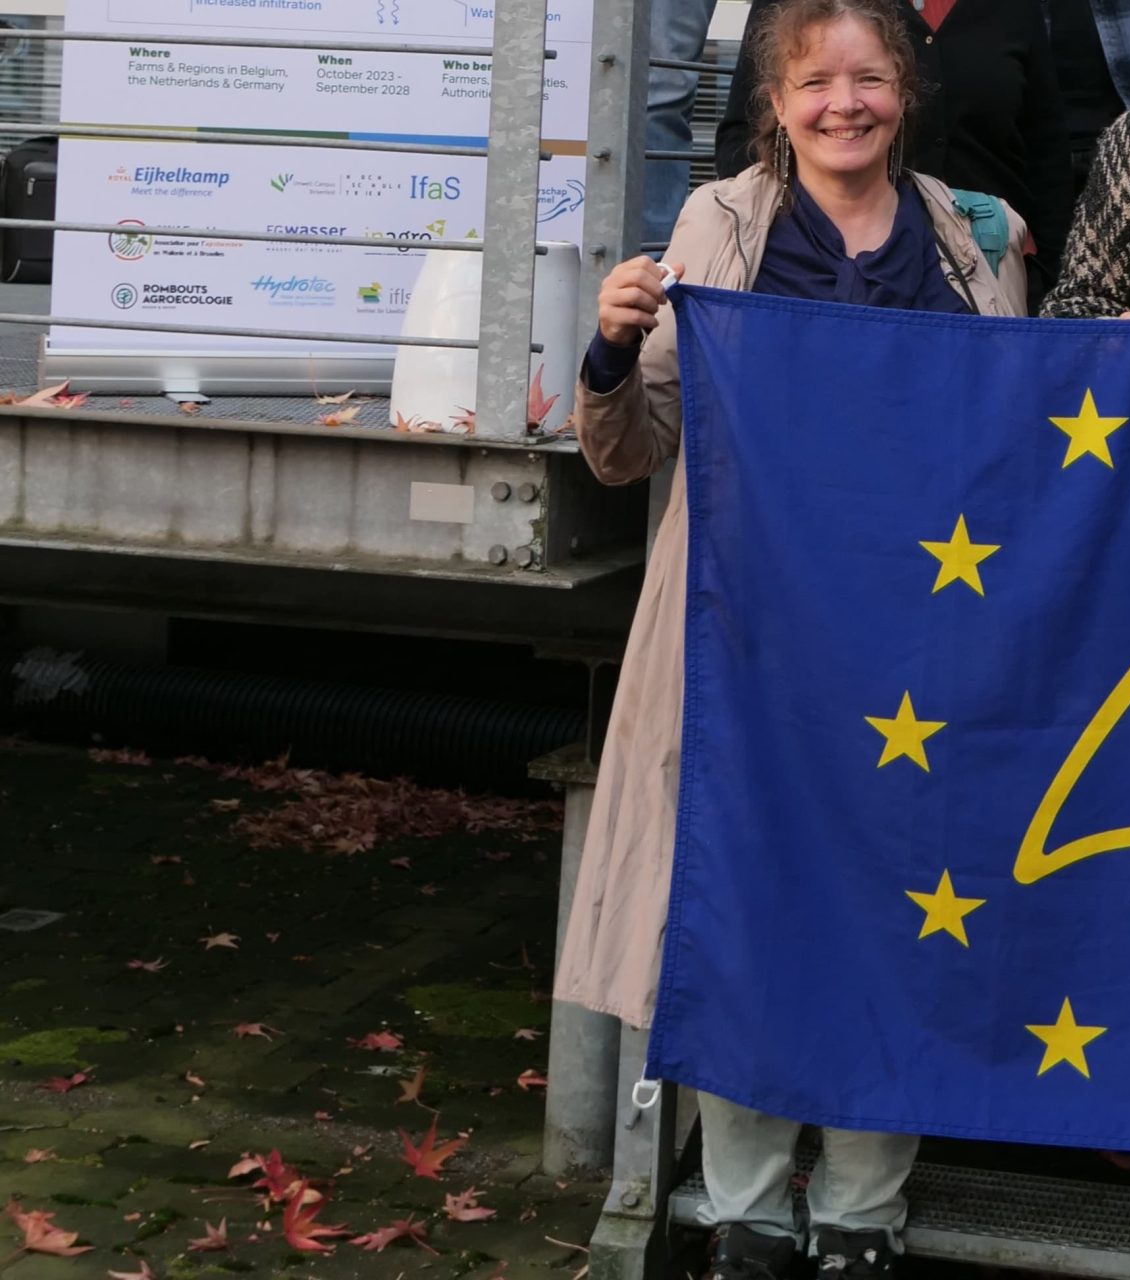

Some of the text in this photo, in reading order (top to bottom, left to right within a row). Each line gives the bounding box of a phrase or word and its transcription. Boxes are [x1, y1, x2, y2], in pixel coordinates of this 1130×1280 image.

[129, 47, 171, 58] Where
[318, 55, 352, 66] When
[443, 60, 470, 70] Who
[128, 61, 289, 79] Farms & Regions in Belgium,
[316, 68, 363, 81] October
[366, 71, 395, 82] 2023
[128, 75, 285, 93] the Netherlands & Germany
[442, 73, 490, 85] Farmers,
[315, 82, 411, 96] September 2028
[134, 167, 230, 188] Eijkelkamp
[131, 187, 214, 198] Meet the difference
[410, 175, 461, 200] IfaS
[143, 284, 208, 295] ROMBOUTS
[251, 275, 336, 298] Hydrotec
[142, 294, 232, 305] AGROECOLOGIE
